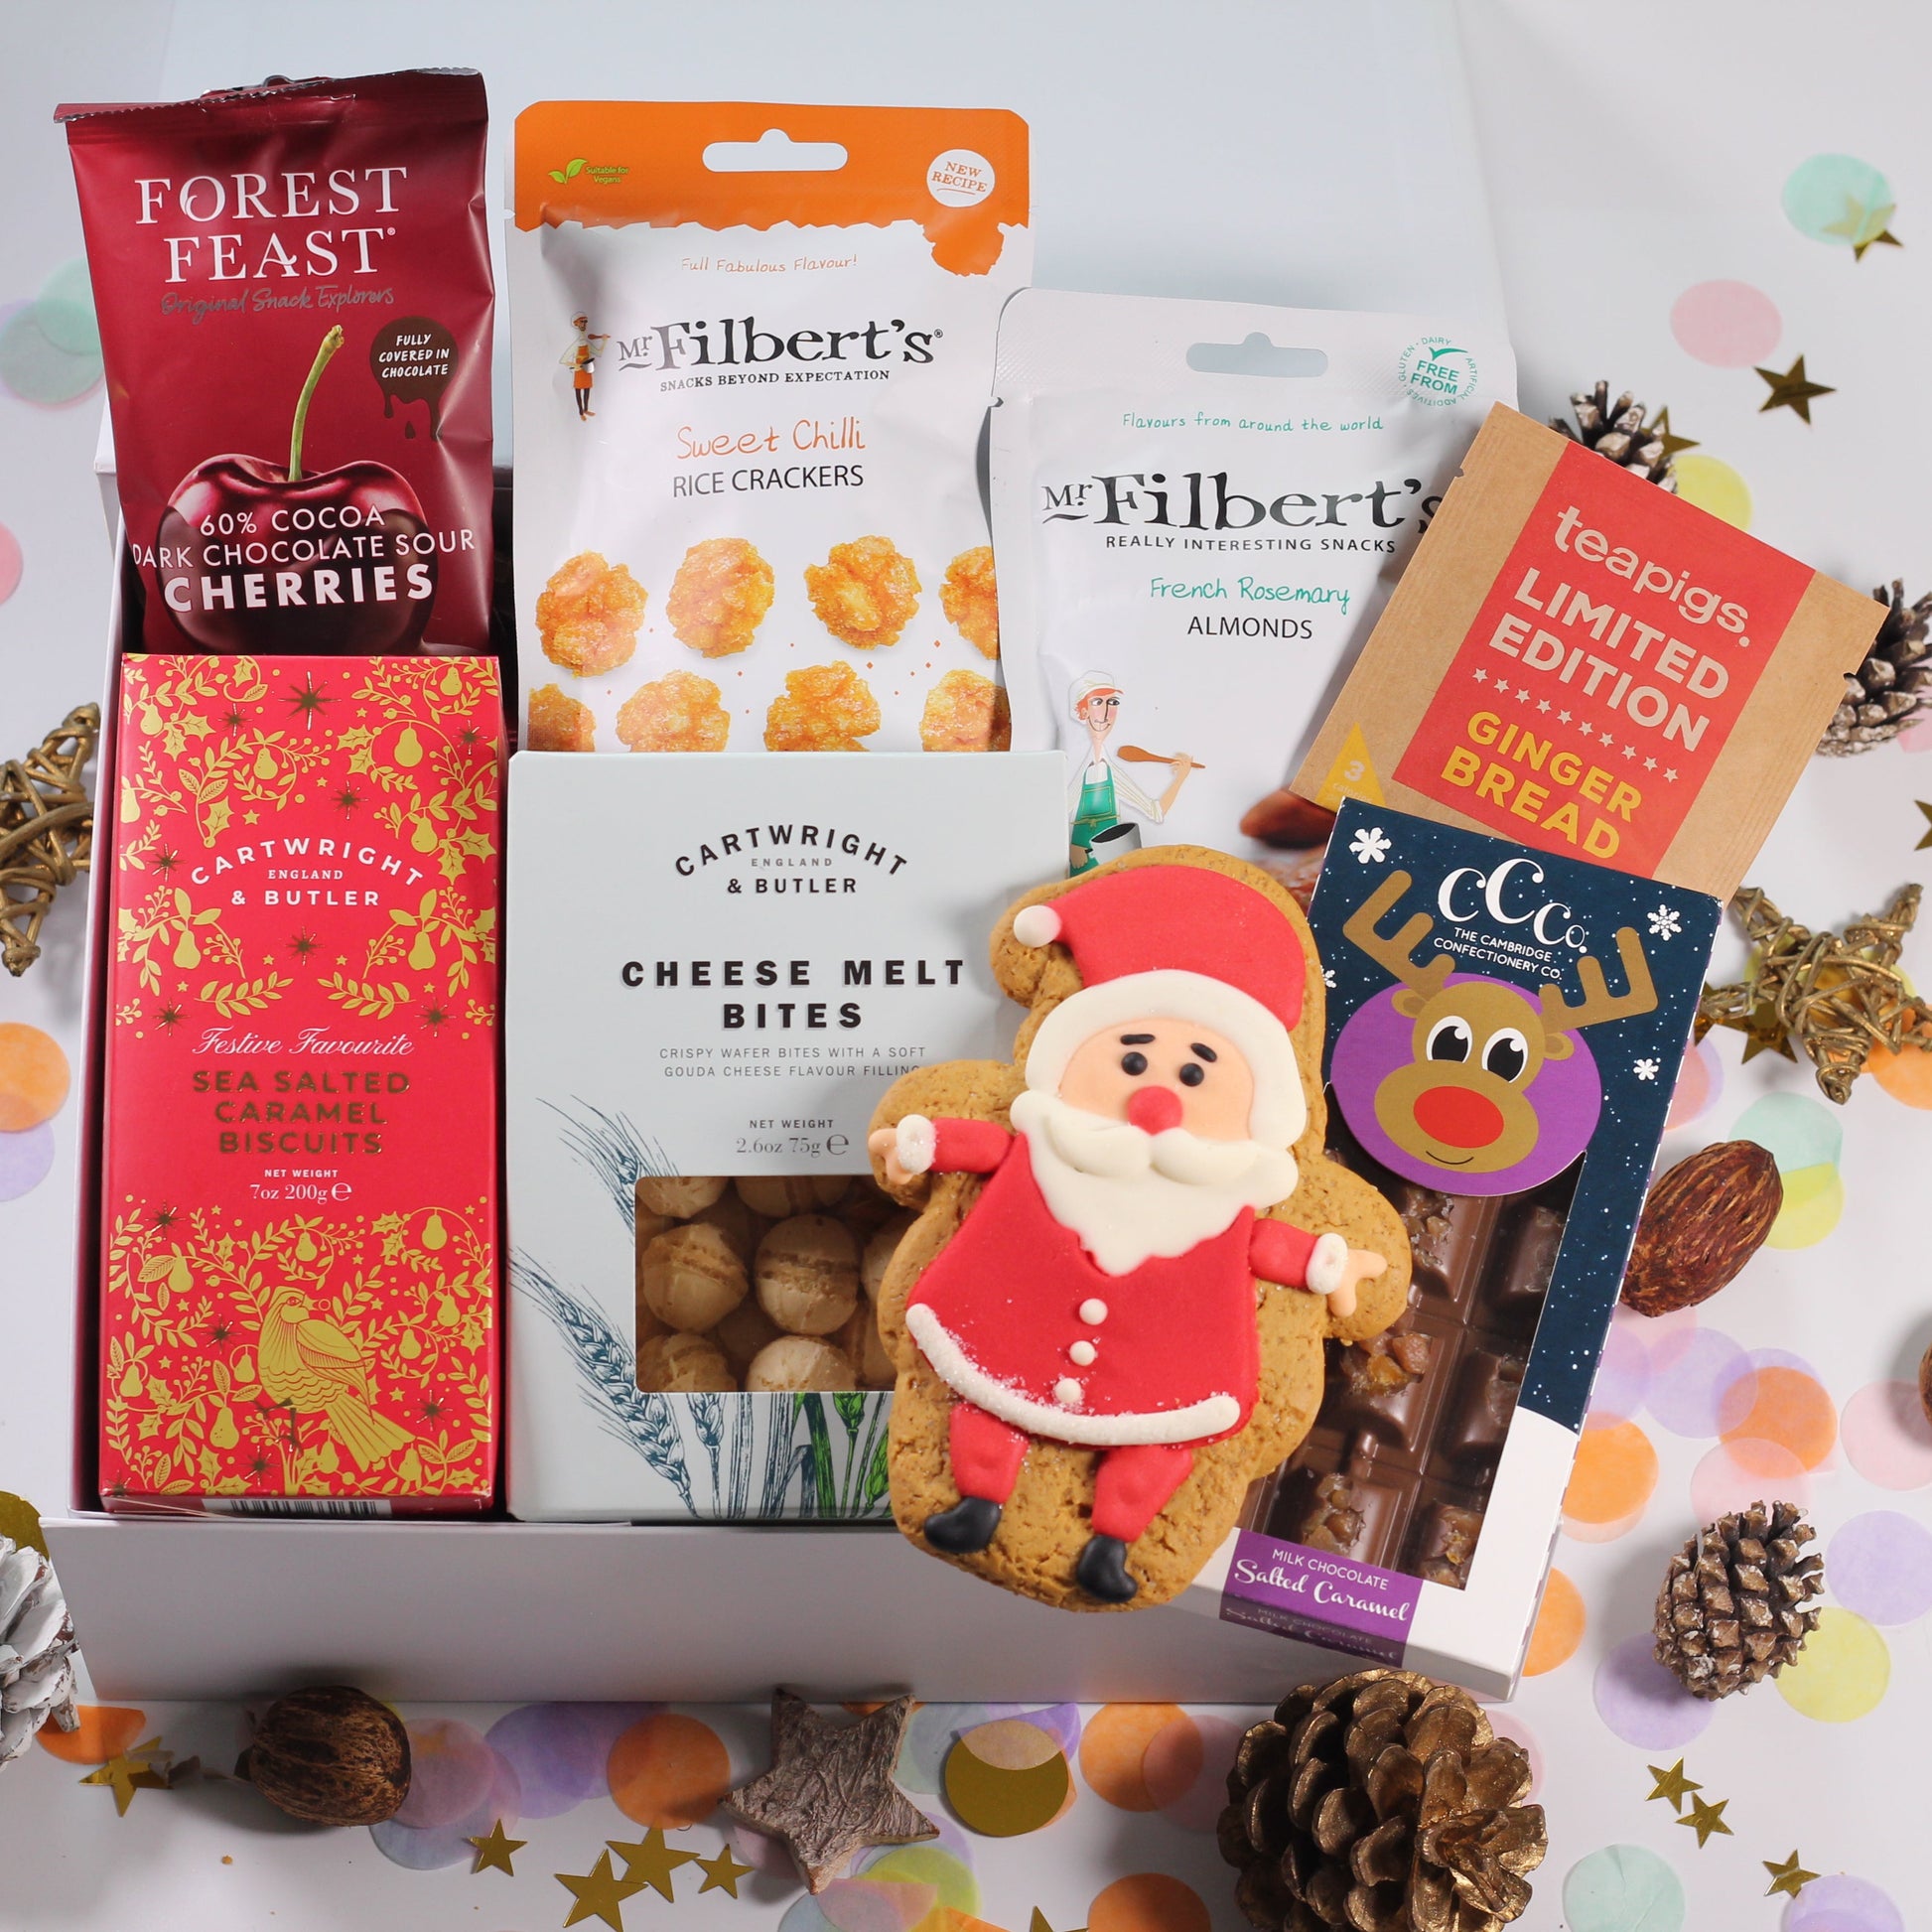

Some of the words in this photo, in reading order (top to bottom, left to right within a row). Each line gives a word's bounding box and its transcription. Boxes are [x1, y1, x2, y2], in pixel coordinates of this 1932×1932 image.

[594, 176, 621, 185] Vegans
[945, 161, 982, 177] NEW
[931, 171, 987, 192] RECIPE
[134, 167, 408, 225] FOREST
[681, 257, 710, 271] Full
[716, 258, 786, 273] Fabulous
[793, 254, 859, 271] Flavour!
[161, 288, 249, 326] Original
[252, 286, 313, 313] Snack
[316, 284, 395, 313] Explorers
[396, 334, 432, 346] FULLY
[378, 348, 433, 362] COVERED
[436, 347, 450, 359] IN
[1398, 345, 1415, 382] GLUTEN
[1421, 337, 1451, 345] DAIRY
[381, 363, 449, 378] CHOCOLATE
[659, 376, 713, 392] SNACKS
[718, 372, 779, 385] BEYOND
[784, 369, 890, 383] EXPECTATION
[1417, 359, 1459, 382] FREE
[1410, 372, 1457, 395] FROM
[1123, 411, 1185, 428] Flavours
[1193, 411, 1231, 427] from
[1238, 418, 1294, 432] around
[1301, 417, 1332, 431] the
[1340, 416, 1384, 431] world
[677, 426, 779, 460] Sweet
[793, 416, 866, 450] Chilli
[673, 471, 725, 497] RICE
[732, 465, 864, 491] CRACKERS
[199, 511, 258, 536] 60%
[271, 504, 385, 532] COCOA
[133, 543, 194, 569] DARK
[203, 534, 384, 566] CHOCOLATE
[395, 528, 476, 556] SOUR
[1105, 535, 1175, 549] REALLY
[1183, 537, 1311, 551] INTERESTING
[1320, 537, 1396, 553] SNACKS
[163, 563, 433, 612] CHERRIES
[1554, 505, 1749, 647] teapigs.
[1151, 577, 1227, 600] French
[1238, 576, 1350, 615] Rosemary
[1187, 616, 1313, 639] ALMONDS
[1514, 567, 1729, 698] LIMITED
[1488, 612, 1710, 753] EDITION
[1344, 759, 1365, 781] 3
[1466, 711, 1642, 823] GINGER
[1441, 745, 1620, 859] BREAD
[191, 837, 423, 886] CARTWRIGHT
[675, 824, 907, 877] CARTWRIGHT
[267, 869, 344, 880] ENGLAND
[751, 858, 833, 868] ENGLAND
[231, 890, 246, 905] &
[264, 890, 379, 905] BUTLER
[727, 879, 742, 894] &
[756, 878, 857, 894] BUTLER
[1453, 926, 1478, 942] THE
[1480, 934, 1553, 962] CAMBRIDGE
[1434, 937, 1539, 974] CONFECTIONERY
[1541, 966, 1563, 980] CO.
[621, 960, 811, 987] CHEESE
[844, 959, 963, 986] MELT
[723, 1003, 862, 1030] BITES
[192, 1026, 283, 1055] Festive
[289, 1026, 414, 1056] Favourite
[659, 1047, 714, 1058] CRISPY
[721, 1047, 770, 1058] WAFER
[778, 1047, 820, 1058] BITES
[828, 1047, 865, 1057] WITH
[873, 1047, 881, 1057] A
[889, 1046, 926, 1057] SOFT
[193, 1070, 258, 1093] SEA
[274, 1070, 410, 1093] SALTED
[664, 1066, 716, 1077] GOUDA
[723, 1066, 781, 1077] CHEESE
[789, 1065, 855, 1076] FLAVOUR
[214, 1101, 387, 1124] CARAMEL
[750, 1119, 773, 1129] NET
[781, 1119, 834, 1129] WEIGHT
[218, 1132, 382, 1155] BISCUITS
[737, 1137, 783, 1154] 2.6oz
[789, 1137, 821, 1158] 75g
[264, 1169, 287, 1177] NET
[292, 1169, 338, 1178] WEIGHT
[249, 1183, 279, 1200] 7oz
[1272, 1549, 1306, 1567] MILK
[1308, 1559, 1389, 1590] CHOCOLATE
[1234, 1559, 1310, 1593] Salted
[1313, 1581, 1411, 1621] Caramel
